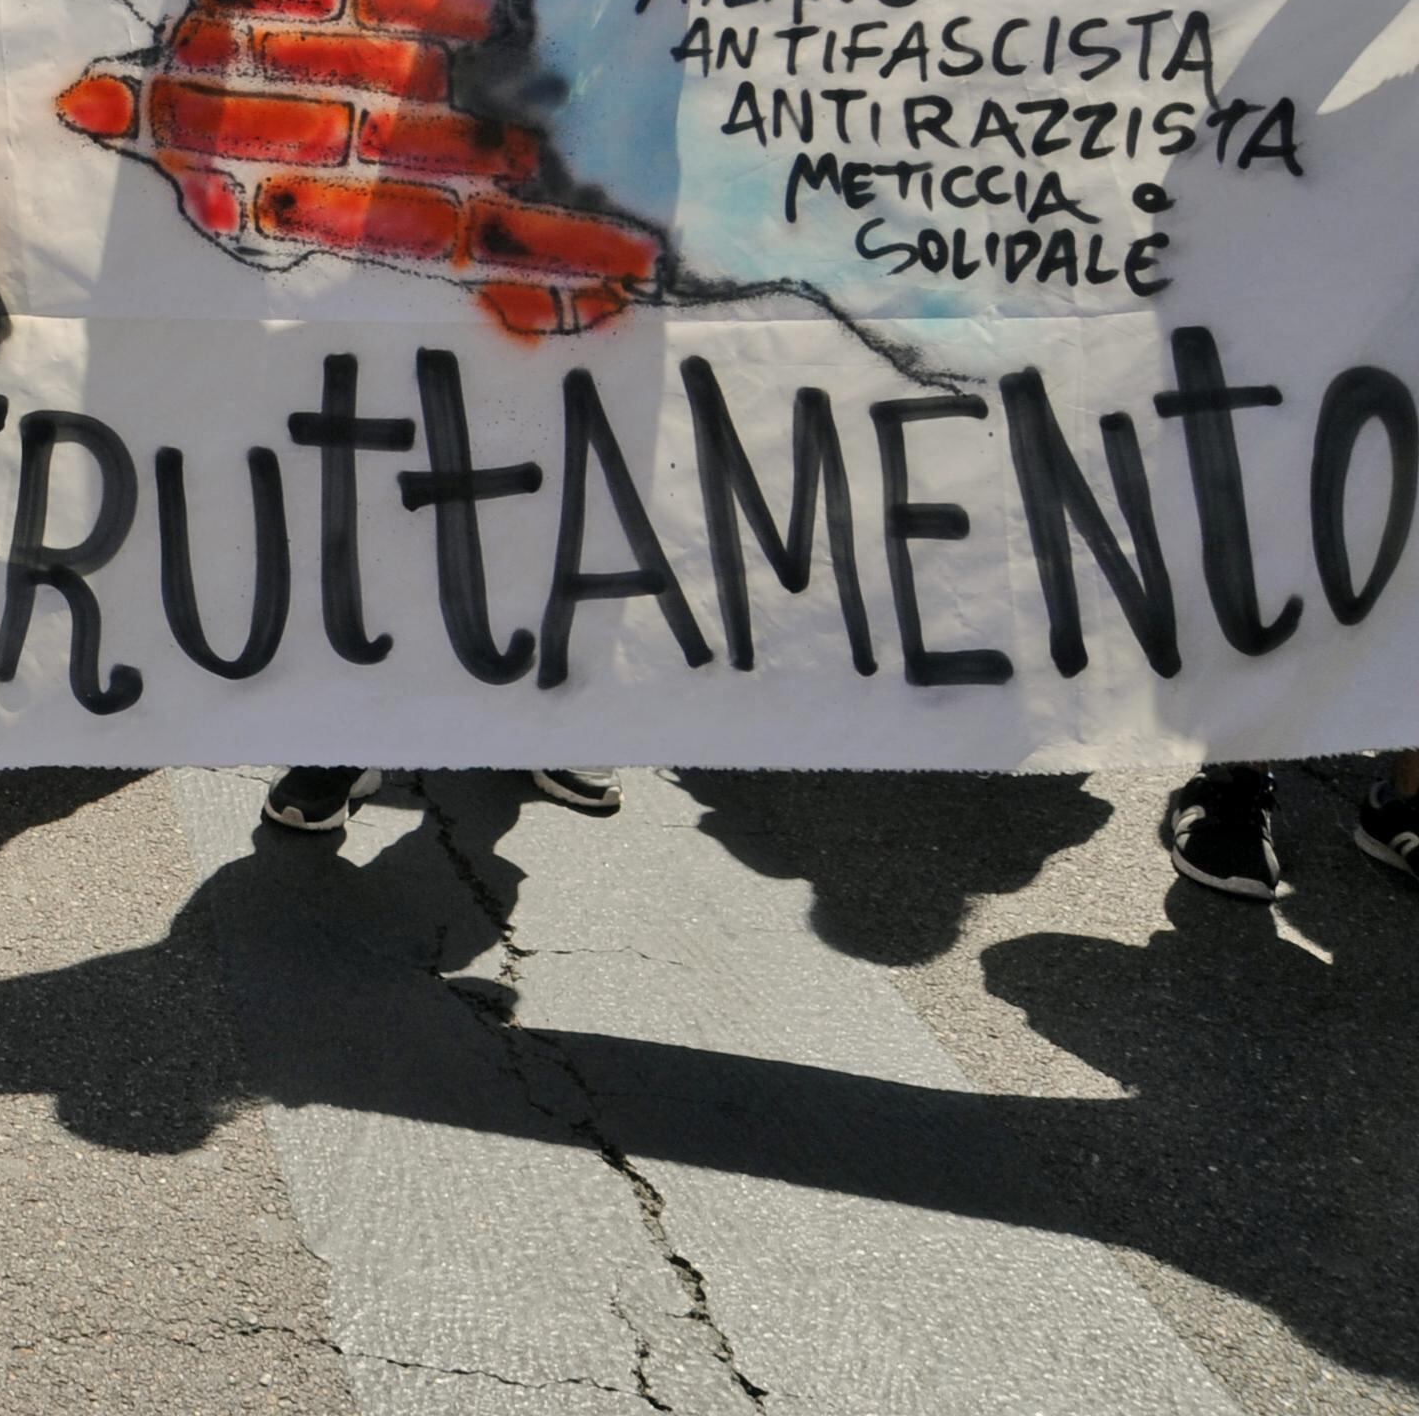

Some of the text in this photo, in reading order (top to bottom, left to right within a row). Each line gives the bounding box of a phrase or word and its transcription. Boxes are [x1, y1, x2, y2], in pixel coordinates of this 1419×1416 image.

[670, 9, 1223, 110] ANTIFASCISTA
[721, 80, 1305, 177] ANTIRAZZISTA
[784, 151, 1099, 224] METICCIA
[855, 217, 1174, 296] SOLIDALE
